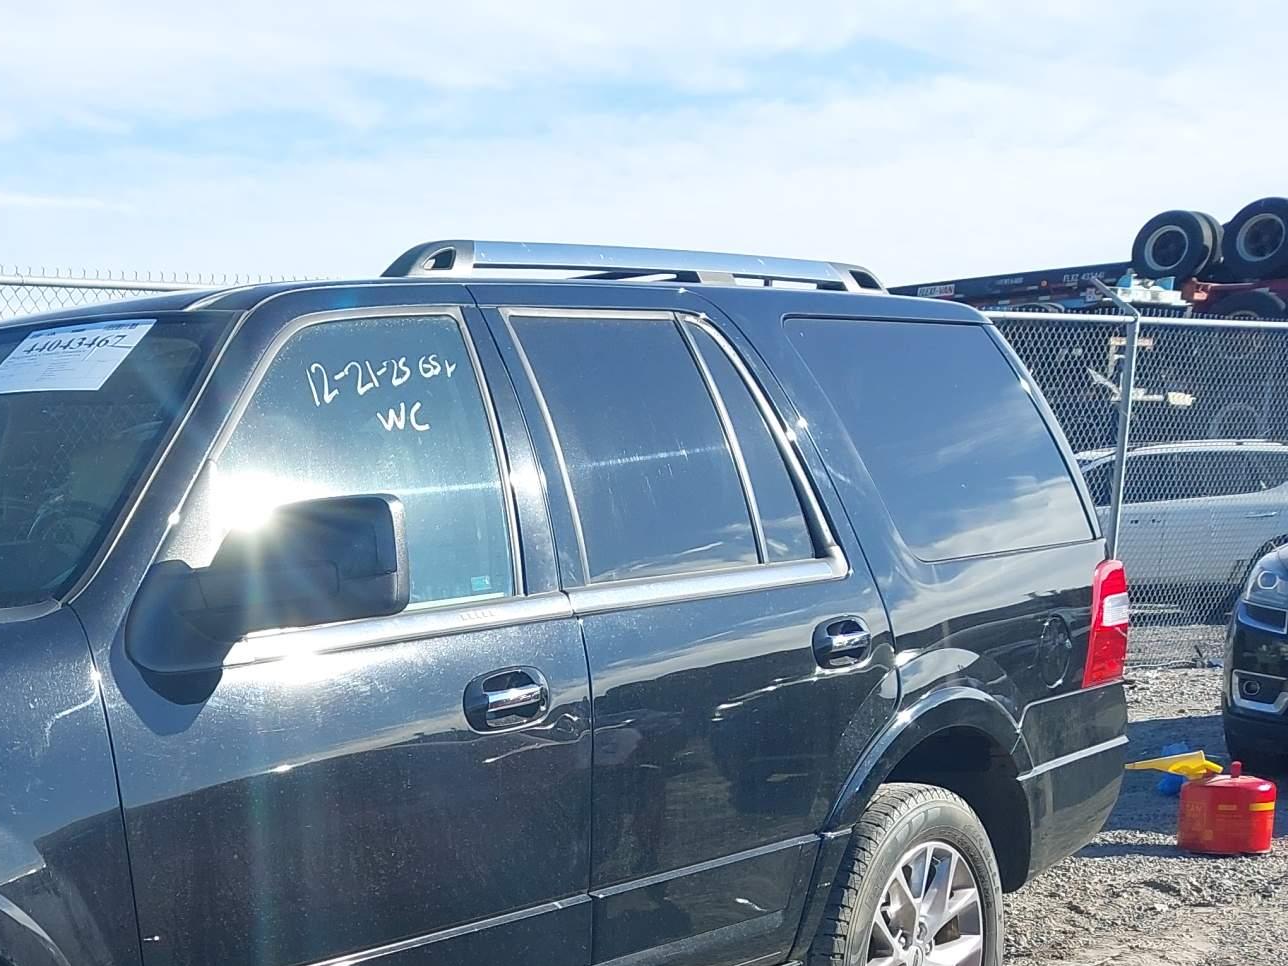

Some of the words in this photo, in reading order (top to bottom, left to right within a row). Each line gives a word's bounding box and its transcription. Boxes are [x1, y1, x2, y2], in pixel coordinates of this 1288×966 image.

[23, 333, 128, 355] 44043467
[305, 356, 411, 407] 12-21-25
[376, 402, 430, 432] WC
